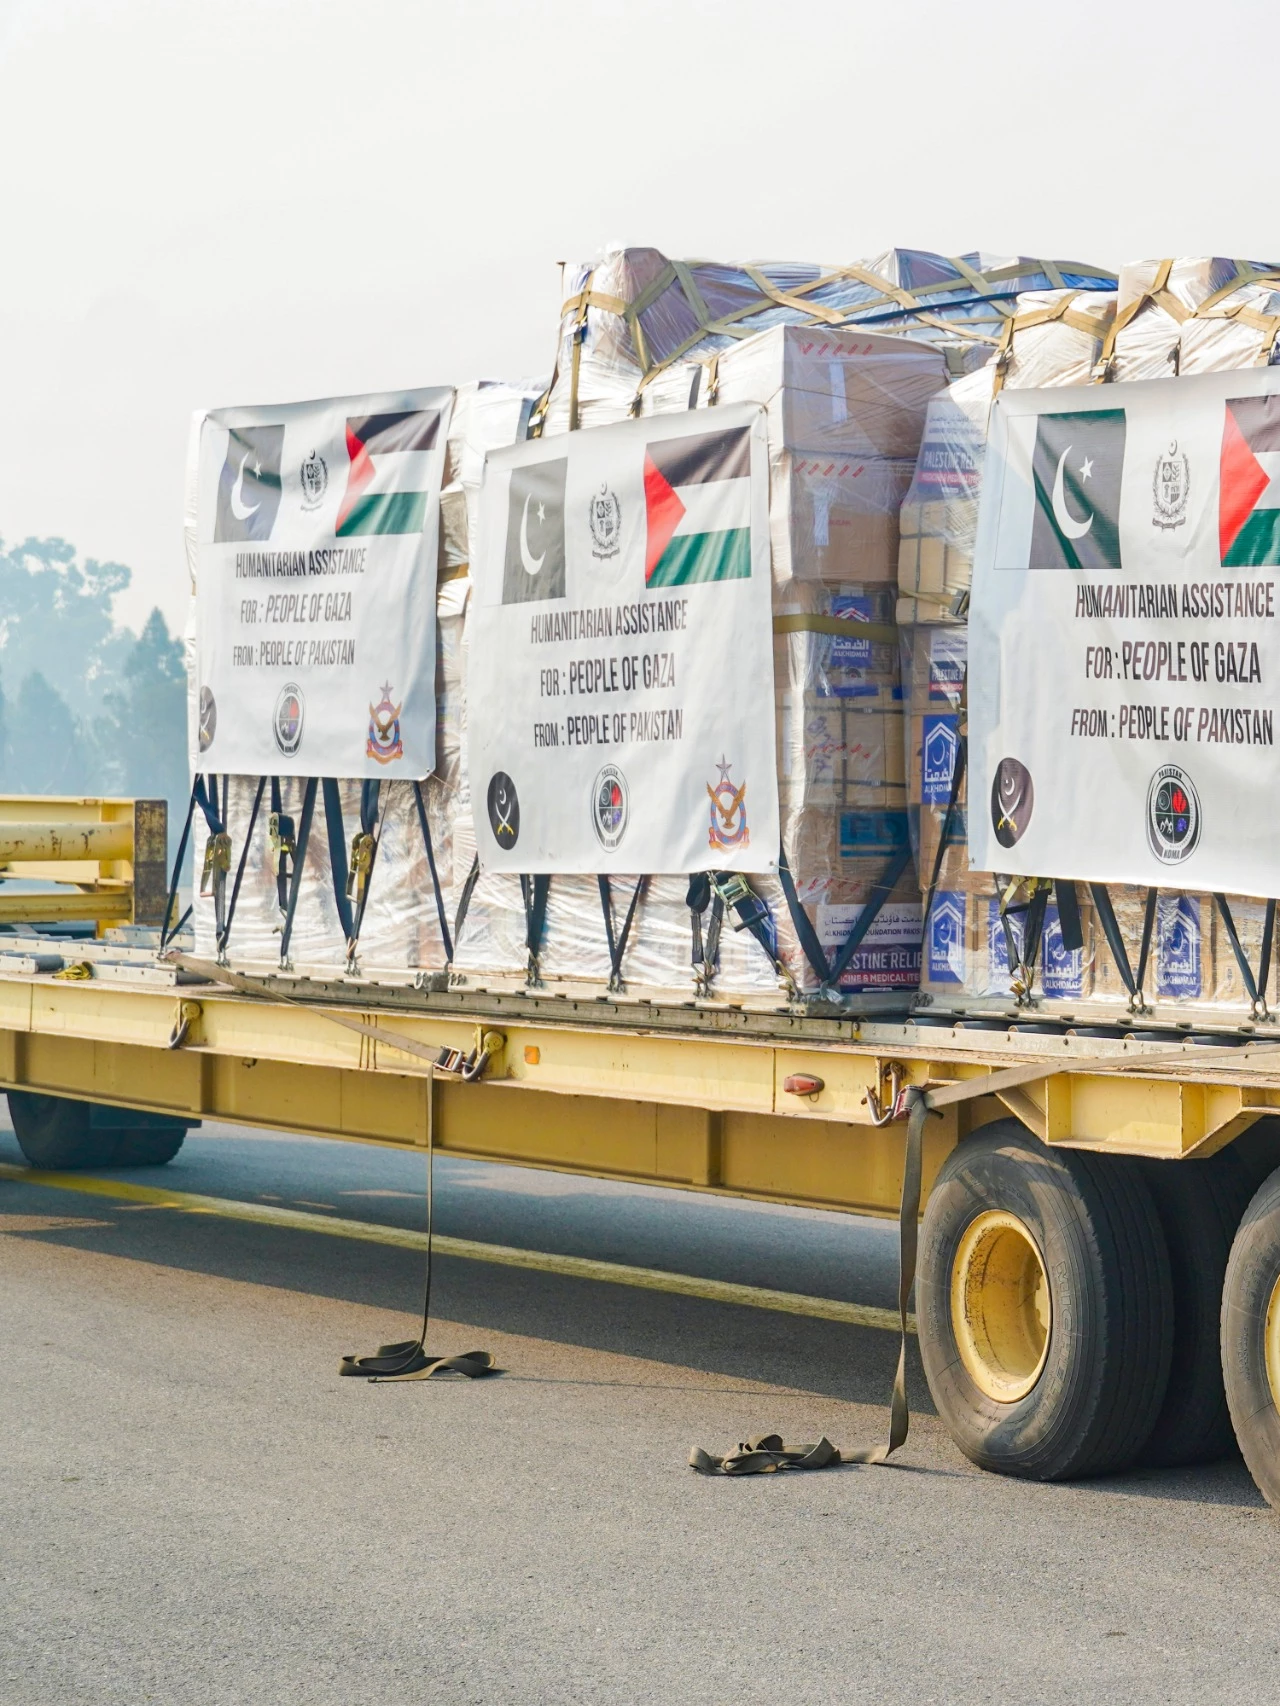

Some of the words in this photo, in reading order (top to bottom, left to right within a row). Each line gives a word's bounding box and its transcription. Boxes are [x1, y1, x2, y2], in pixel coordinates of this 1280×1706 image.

[236, 551, 306, 578] HUMANITARIAN
[309, 548, 367, 575] ASSISTANCE
[240, 600, 258, 623] FOR
[265, 594, 309, 623] PEOPLE
[309, 593, 324, 622] OF
[325, 592, 352, 621] GAZA
[1075, 584, 1178, 618] HUMANITARIAN
[1182, 582, 1275, 618] ASSISTANCE
[531, 607, 612, 644] HUMANITARIAN
[616, 599, 688, 637] ASSISTANCE
[233, 645, 254, 666] FROM
[260, 640, 294, 666] PEOPLE
[294, 640, 308, 665] OF
[308, 639, 355, 665] PAKISTAN
[1086, 646, 1112, 679] FOR
[1122, 641, 1188, 682] PEOPLE
[1190, 642, 1209, 682] OF
[1215, 642, 1261, 683] GAZA
[540, 668, 560, 697] FOR
[570, 658, 619, 695] PEOPLE
[622, 656, 638, 691] OF
[643, 652, 675, 689] GAZA
[534, 722, 559, 747] FROM
[567, 714, 610, 746] PEOPLE
[613, 713, 627, 743] OF
[630, 709, 683, 742] PAKISTAN
[1071, 708, 1108, 738] FROM
[1119, 705, 1169, 741] PEOPLE
[1174, 707, 1195, 741] OF
[1197, 708, 1273, 745] PAKISTAN
[870, 973, 905, 983] MEDICAL
